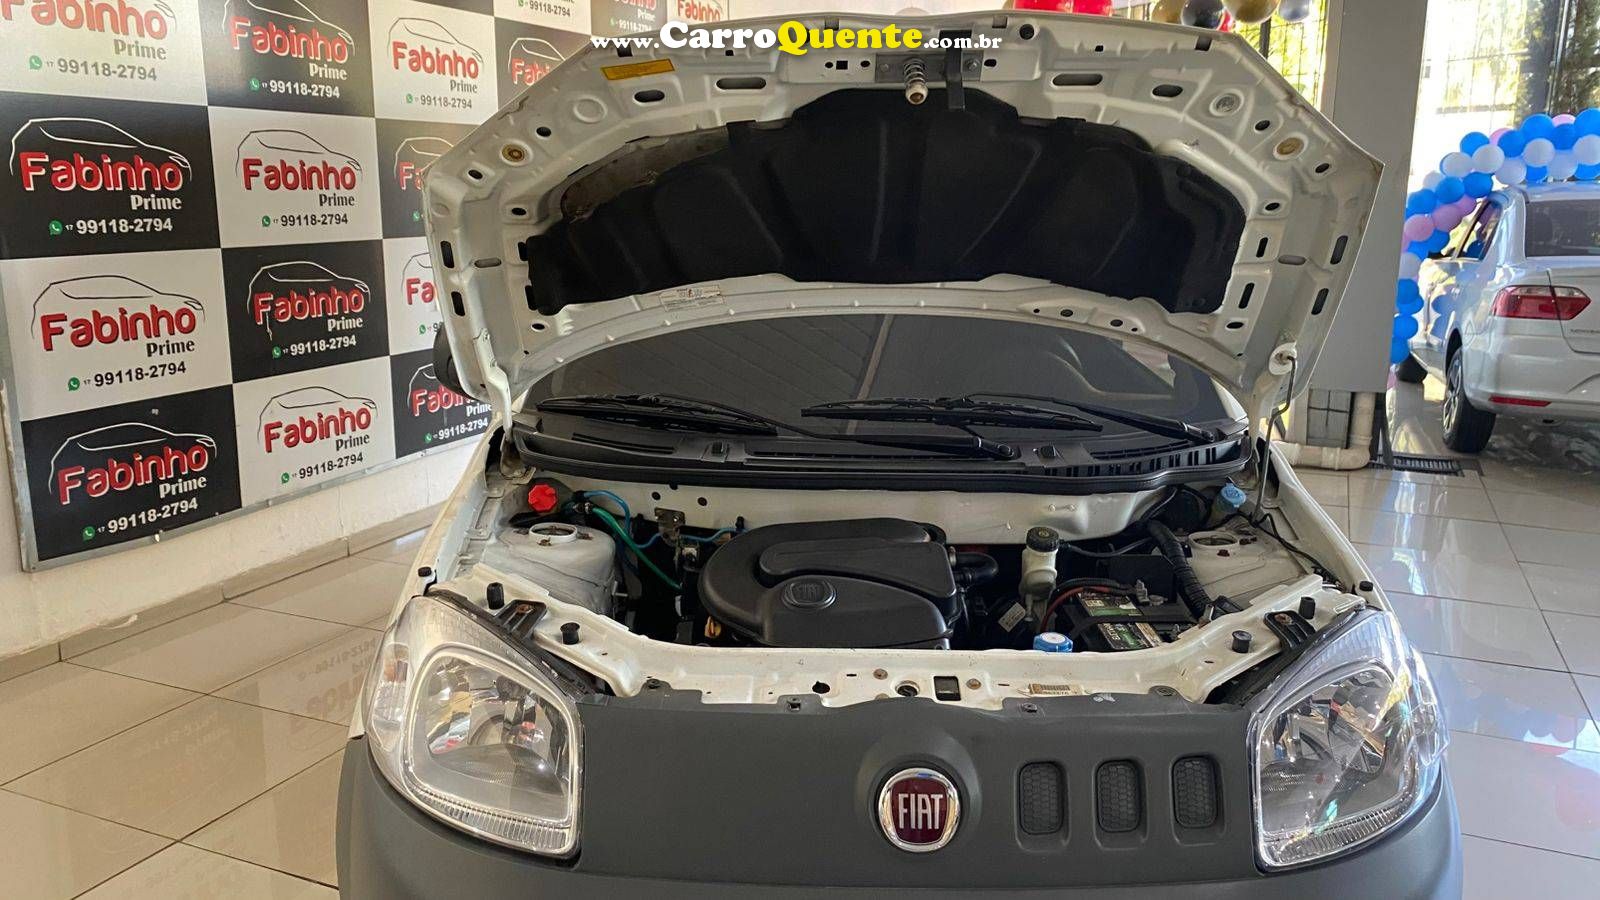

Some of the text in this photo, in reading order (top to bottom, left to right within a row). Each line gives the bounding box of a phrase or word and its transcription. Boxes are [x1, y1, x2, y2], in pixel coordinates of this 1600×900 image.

[530, 0, 571, 17] 99118-2794
[113, 38, 167, 60] Prime
[229, 16, 349, 64] Fabinho
[57, 57, 158, 81] 99118-2794
[392, 40, 479, 79] Fabinho
[308, 62, 348, 80] Prime
[269, 79, 340, 98] 99118-2794
[449, 79, 478, 94] Prime
[420, 94, 472, 109] 99118-2794
[19, 151, 183, 191] Fabinho
[242, 158, 357, 191] Fabinho
[130, 193, 182, 210] Prime
[319, 192, 355, 207] Prime
[76, 217, 173, 234] 99118-2794
[280, 213, 348, 227] 99118-2794
[254, 286, 365, 325] Fabinho
[40, 304, 196, 351] Fabinho
[327, 316, 363, 332] Prime
[146, 339, 195, 357] Prime
[290, 334, 357, 356] 99118-2794
[94, 361, 186, 387] 99118-2794
[264, 407, 371, 453] Fabinho
[438, 417, 489, 440] 99118-2794
[335, 434, 370, 451] Prime
[57, 445, 209, 506] Fabinho
[299, 452, 364, 479] 99118-2794
[159, 476, 207, 498] Prime
[107, 497, 198, 534] 99118-2794
[898, 793, 943, 830] FIAT
